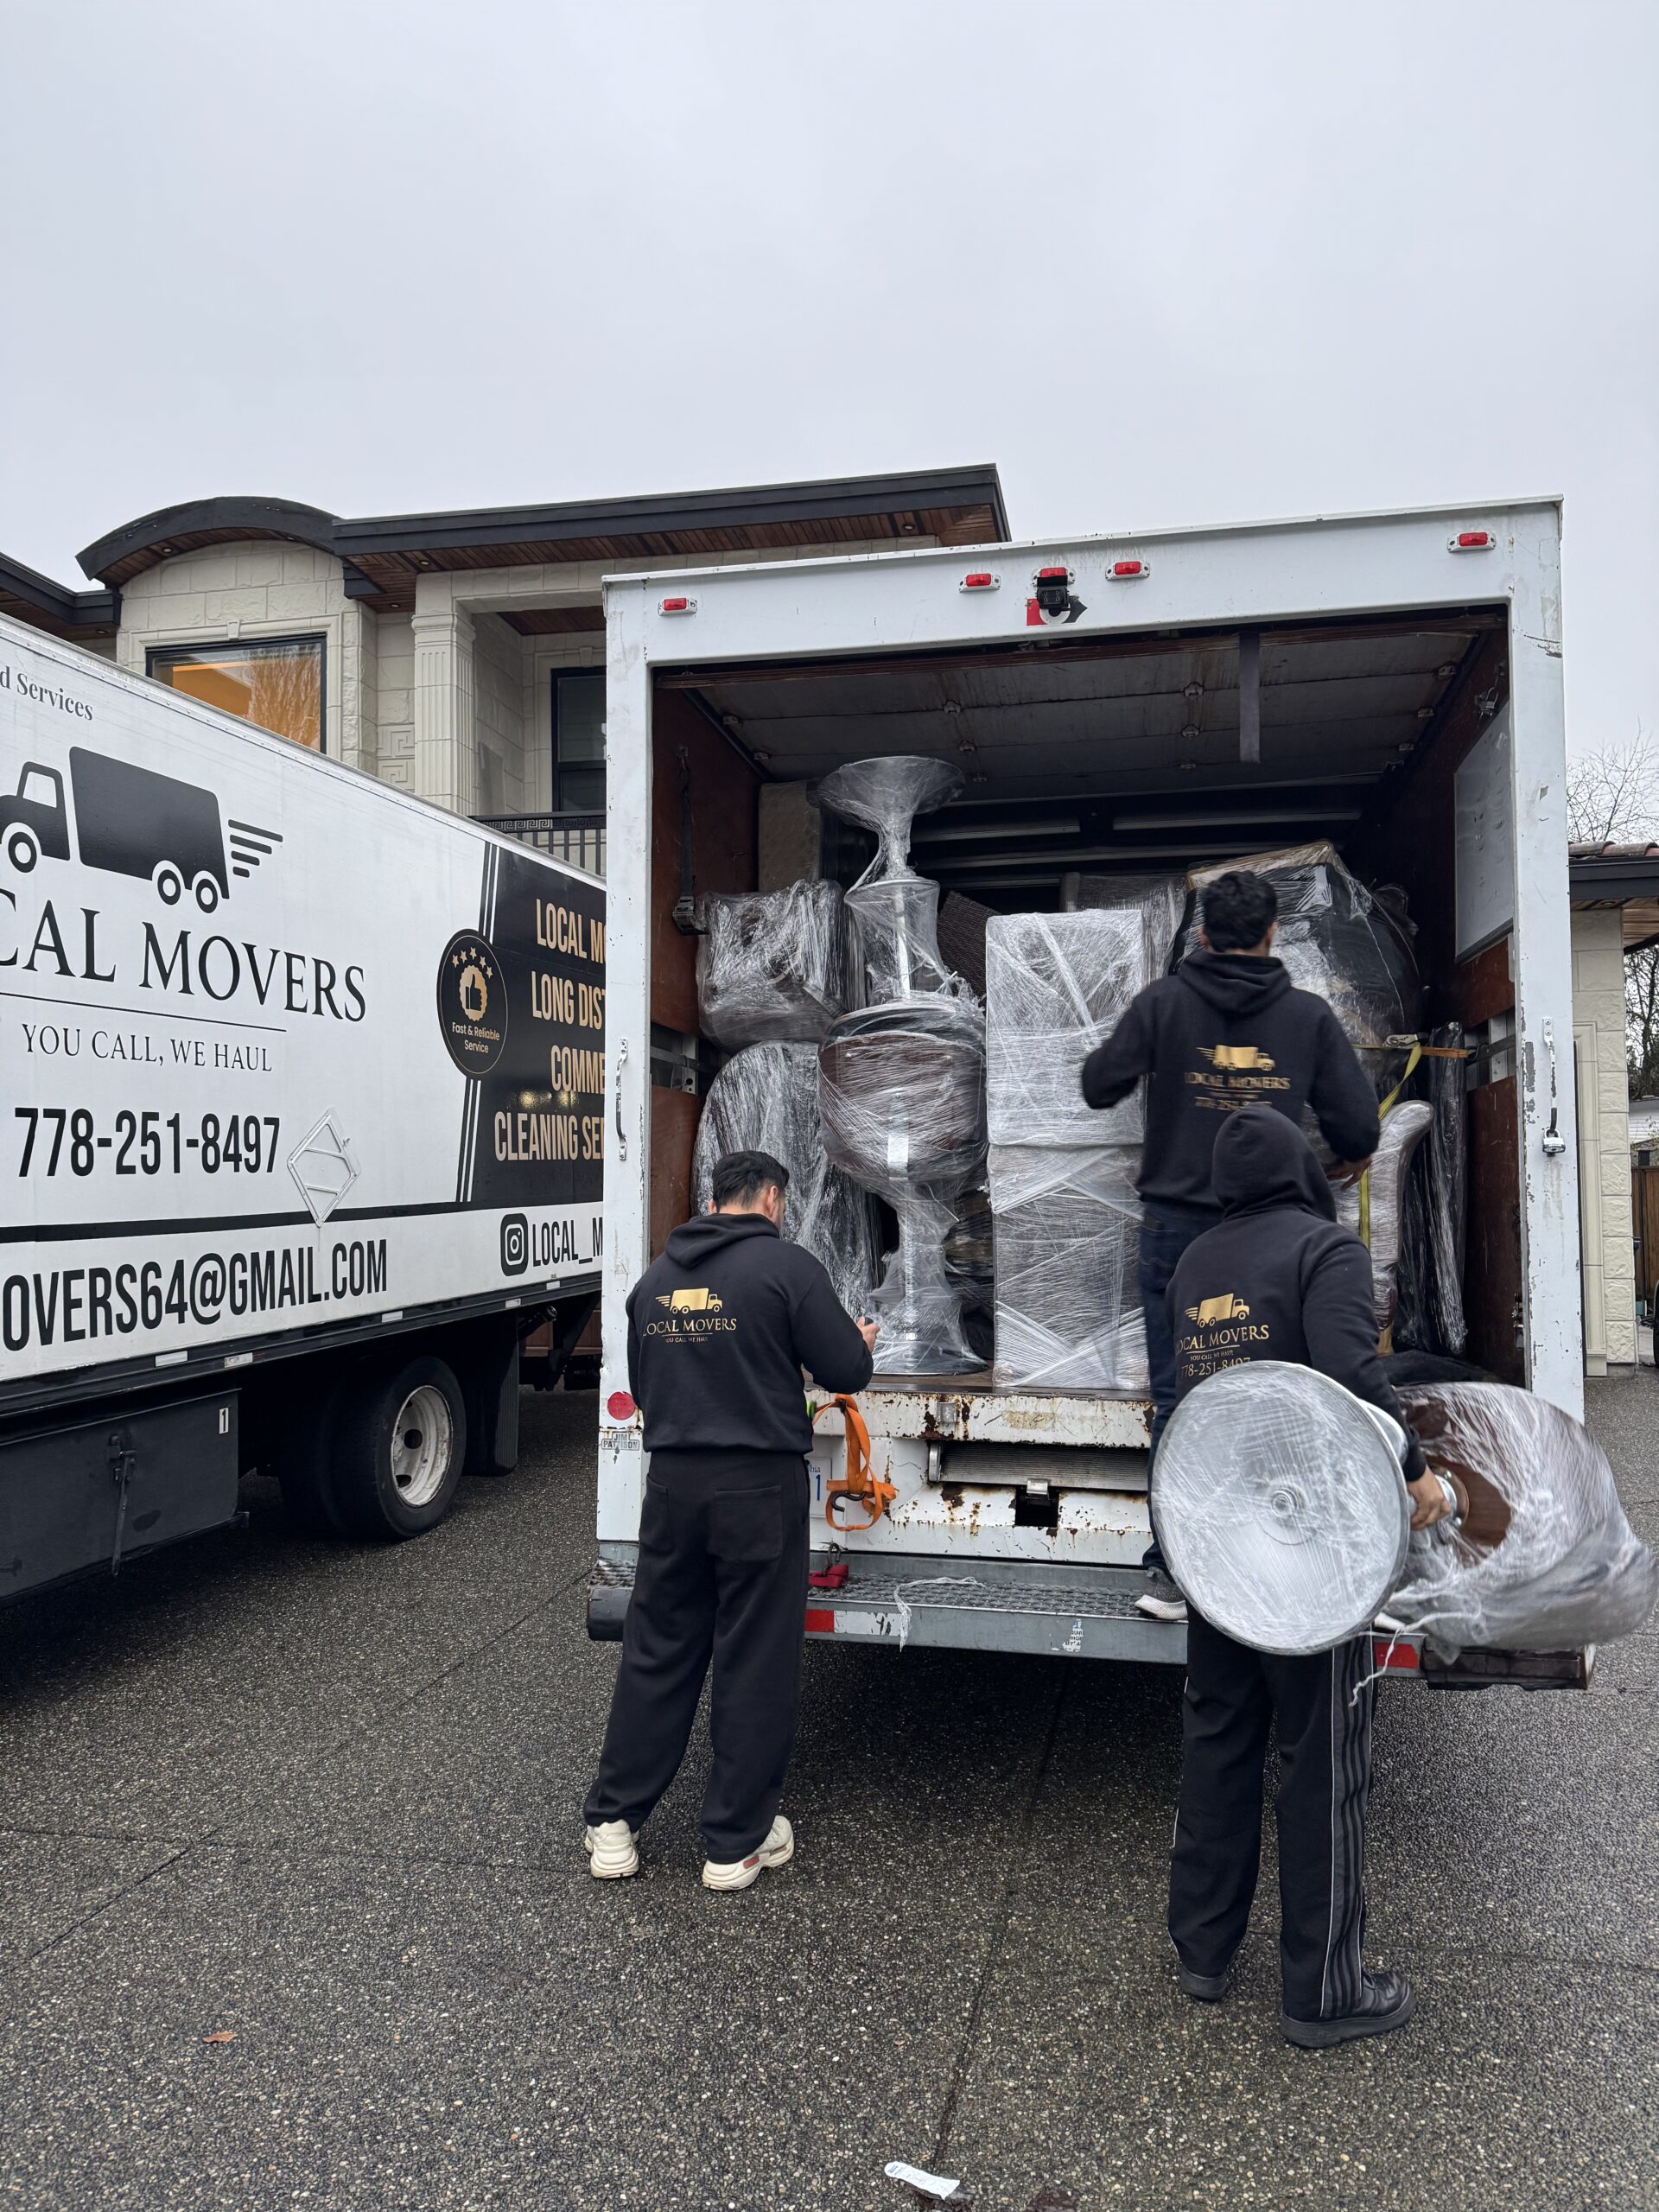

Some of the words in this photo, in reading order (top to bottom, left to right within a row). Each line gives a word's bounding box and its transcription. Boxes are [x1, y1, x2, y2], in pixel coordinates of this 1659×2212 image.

[17, 673, 92, 721] Services
[536, 899, 587, 959] LOCAL
[590, 918, 607, 963] M
[139, 922, 366, 1022] MOVERS
[531, 970, 574, 1025] LONG
[22, 1023, 81, 1057] YOU
[92, 1031, 164, 1066] CALL,
[171, 1039, 206, 1066] WE
[214, 1044, 272, 1072] HAUL
[452, 1022, 467, 1034] Fast
[467, 1025, 474, 1036] &
[474, 1027, 500, 1040] Reliable
[464, 1039, 489, 1053] Service
[15, 1107, 281, 1177] 778-251-8497
[494, 1111, 577, 1161] CLEANING
[582, 1116, 605, 1160] SE
[3, 1239, 387, 1351] OVERS64@GMAIL.COM
[683, 1318, 737, 1332] MOVERS
[1210, 1325, 1269, 1346] MOVERS
[603, 1440, 638, 1449] PATTISON
